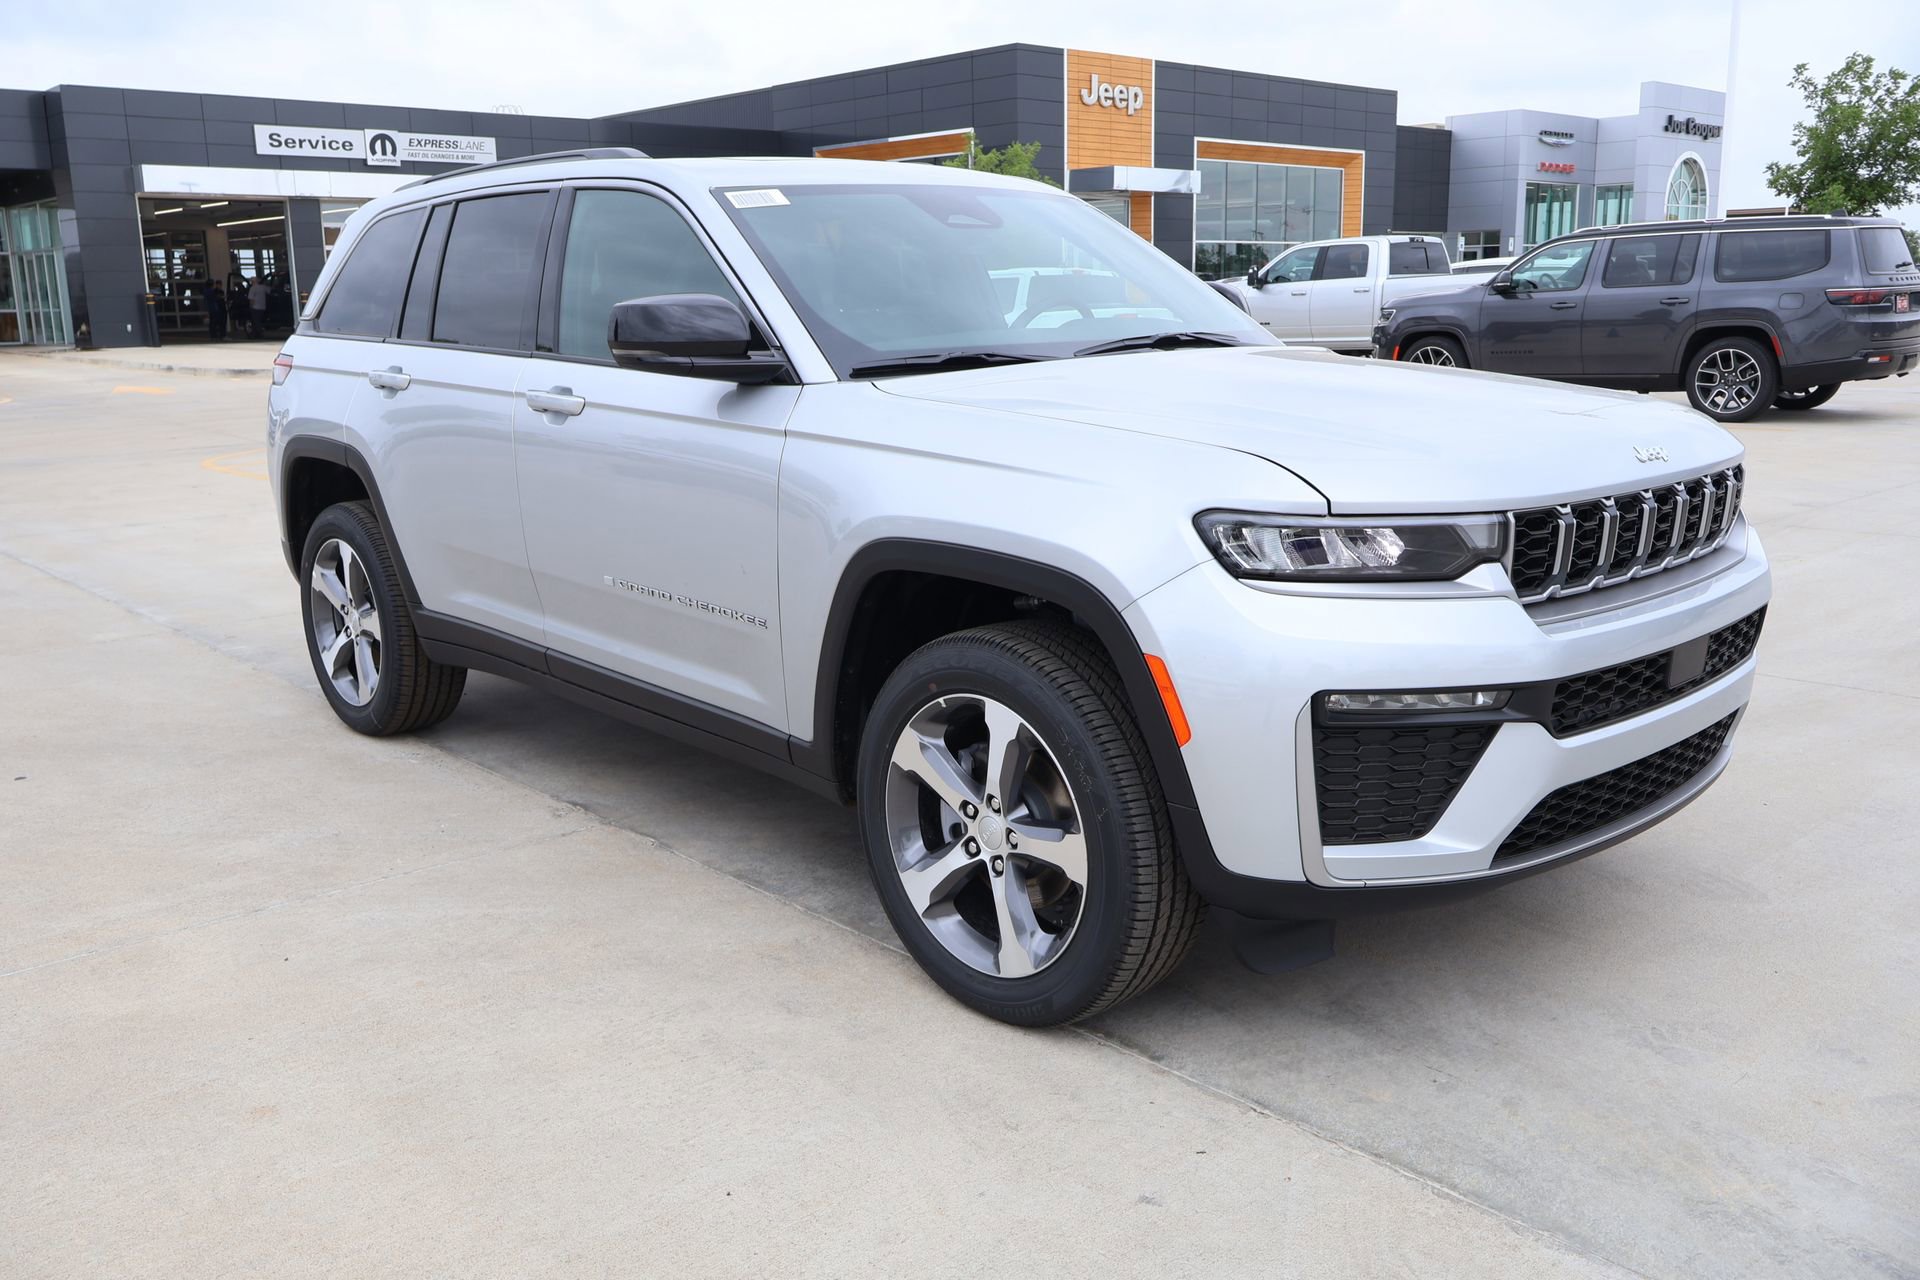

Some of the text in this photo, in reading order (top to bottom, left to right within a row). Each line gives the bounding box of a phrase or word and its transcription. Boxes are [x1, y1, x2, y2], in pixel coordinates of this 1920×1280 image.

[1081, 73, 1144, 116] Jeep
[268, 132, 354, 151] Service
[430, 152, 455, 160] CHANGES
[1633, 446, 1669, 463] Jeep
[618, 579, 768, 629] GRAND CHEROKEE
